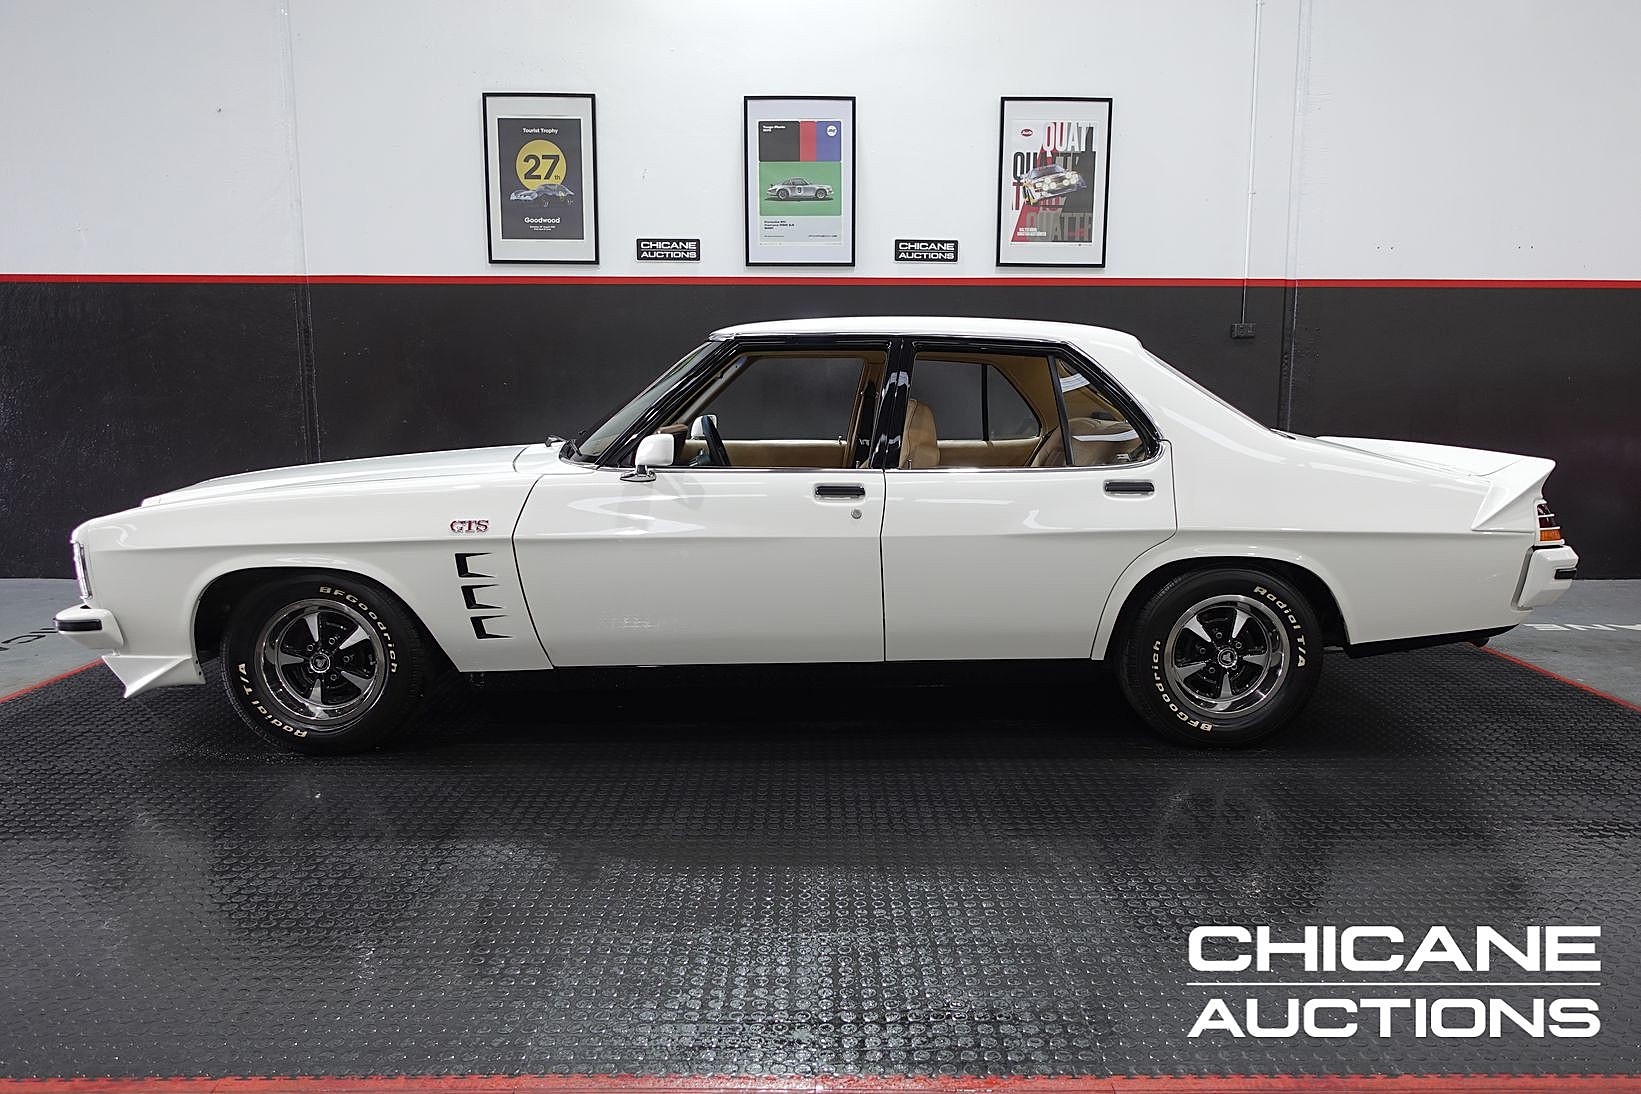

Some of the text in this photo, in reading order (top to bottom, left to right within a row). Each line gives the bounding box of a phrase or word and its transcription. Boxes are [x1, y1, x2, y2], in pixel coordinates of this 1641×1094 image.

[540, 127, 559, 135] Trophy
[524, 216, 561, 224] Goodwood
[640, 241, 697, 249] CHICANE
[898, 242, 955, 250] CHICANE
[449, 520, 489, 533] GTS
[319, 586, 398, 673] BFGoodrich
[1253, 585, 1306, 667] Radial T/A
[1151, 640, 1213, 732] BFGoodrich
[251, 699, 308, 738] Radial
